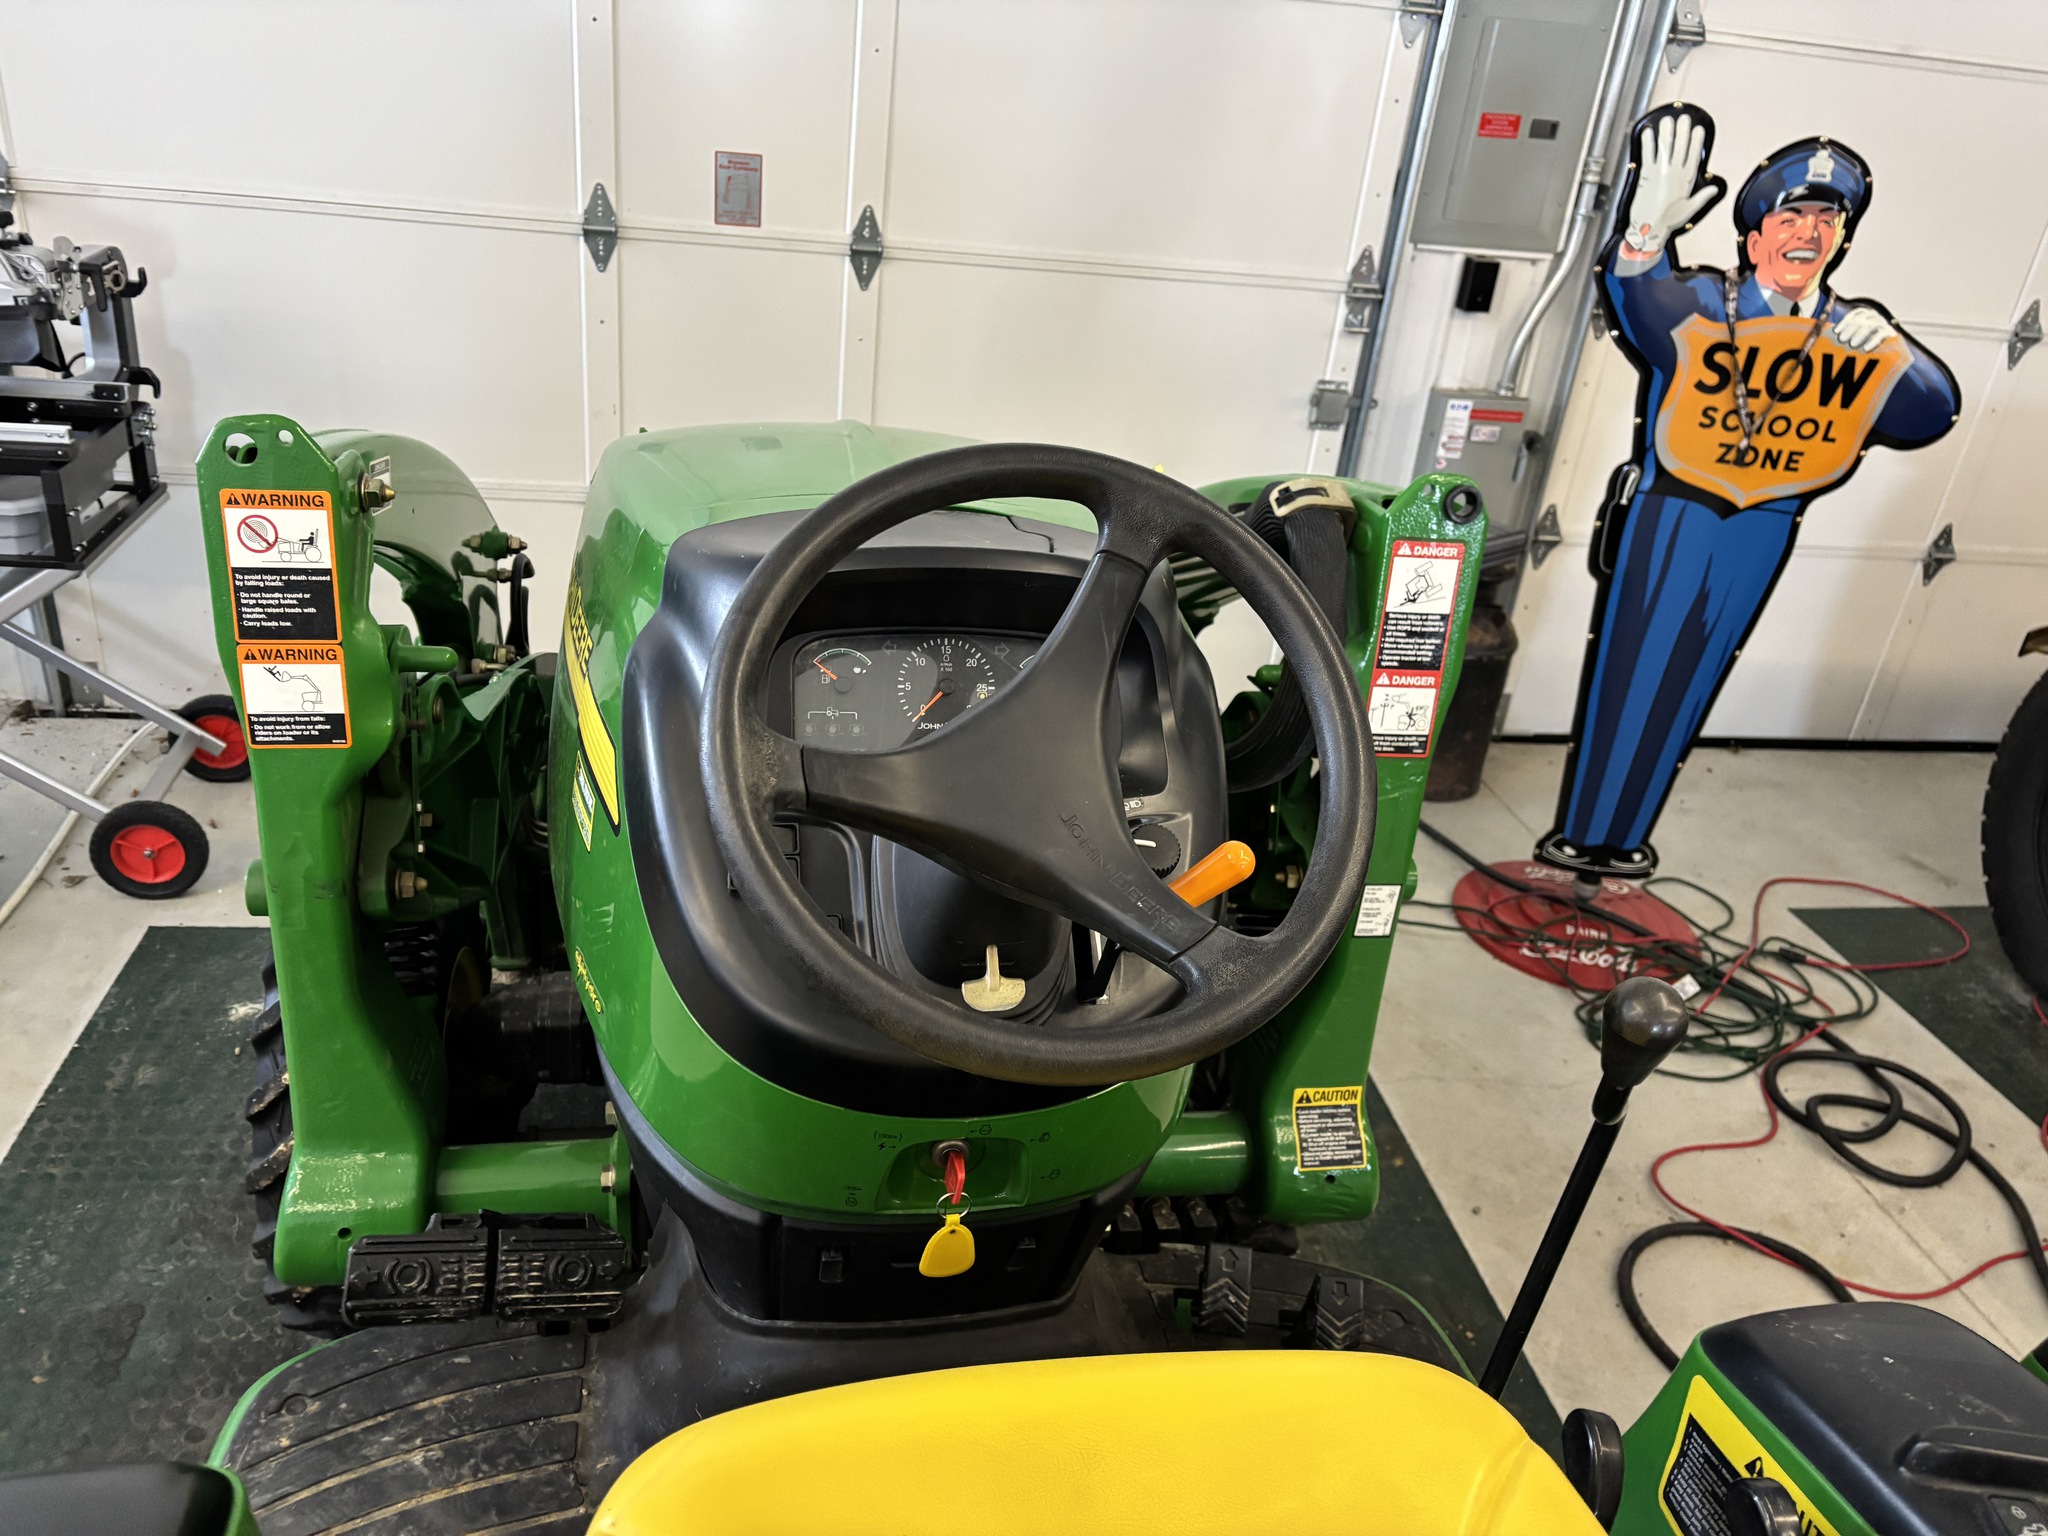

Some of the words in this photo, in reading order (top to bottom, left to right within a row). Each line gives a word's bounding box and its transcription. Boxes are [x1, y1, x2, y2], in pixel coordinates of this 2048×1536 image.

[1694, 342, 1880, 409] SLOW
[1715, 443, 1805, 472] ZONE
[241, 493, 324, 507] WARNING
[1413, 546, 1458, 557] DANGER
[258, 648, 337, 660] WARNING
[941, 646, 951, 654] 15
[915, 658, 925, 666] 10
[966, 659, 977, 667] 20
[905, 682, 911, 690] 5
[1391, 675, 1435, 686] DANGER
[977, 684, 987, 692] 25
[1059, 814, 1112, 874] JOHN
[1109, 871, 1183, 933] DEERE
[1313, 1089, 1358, 1102] CAUTION
